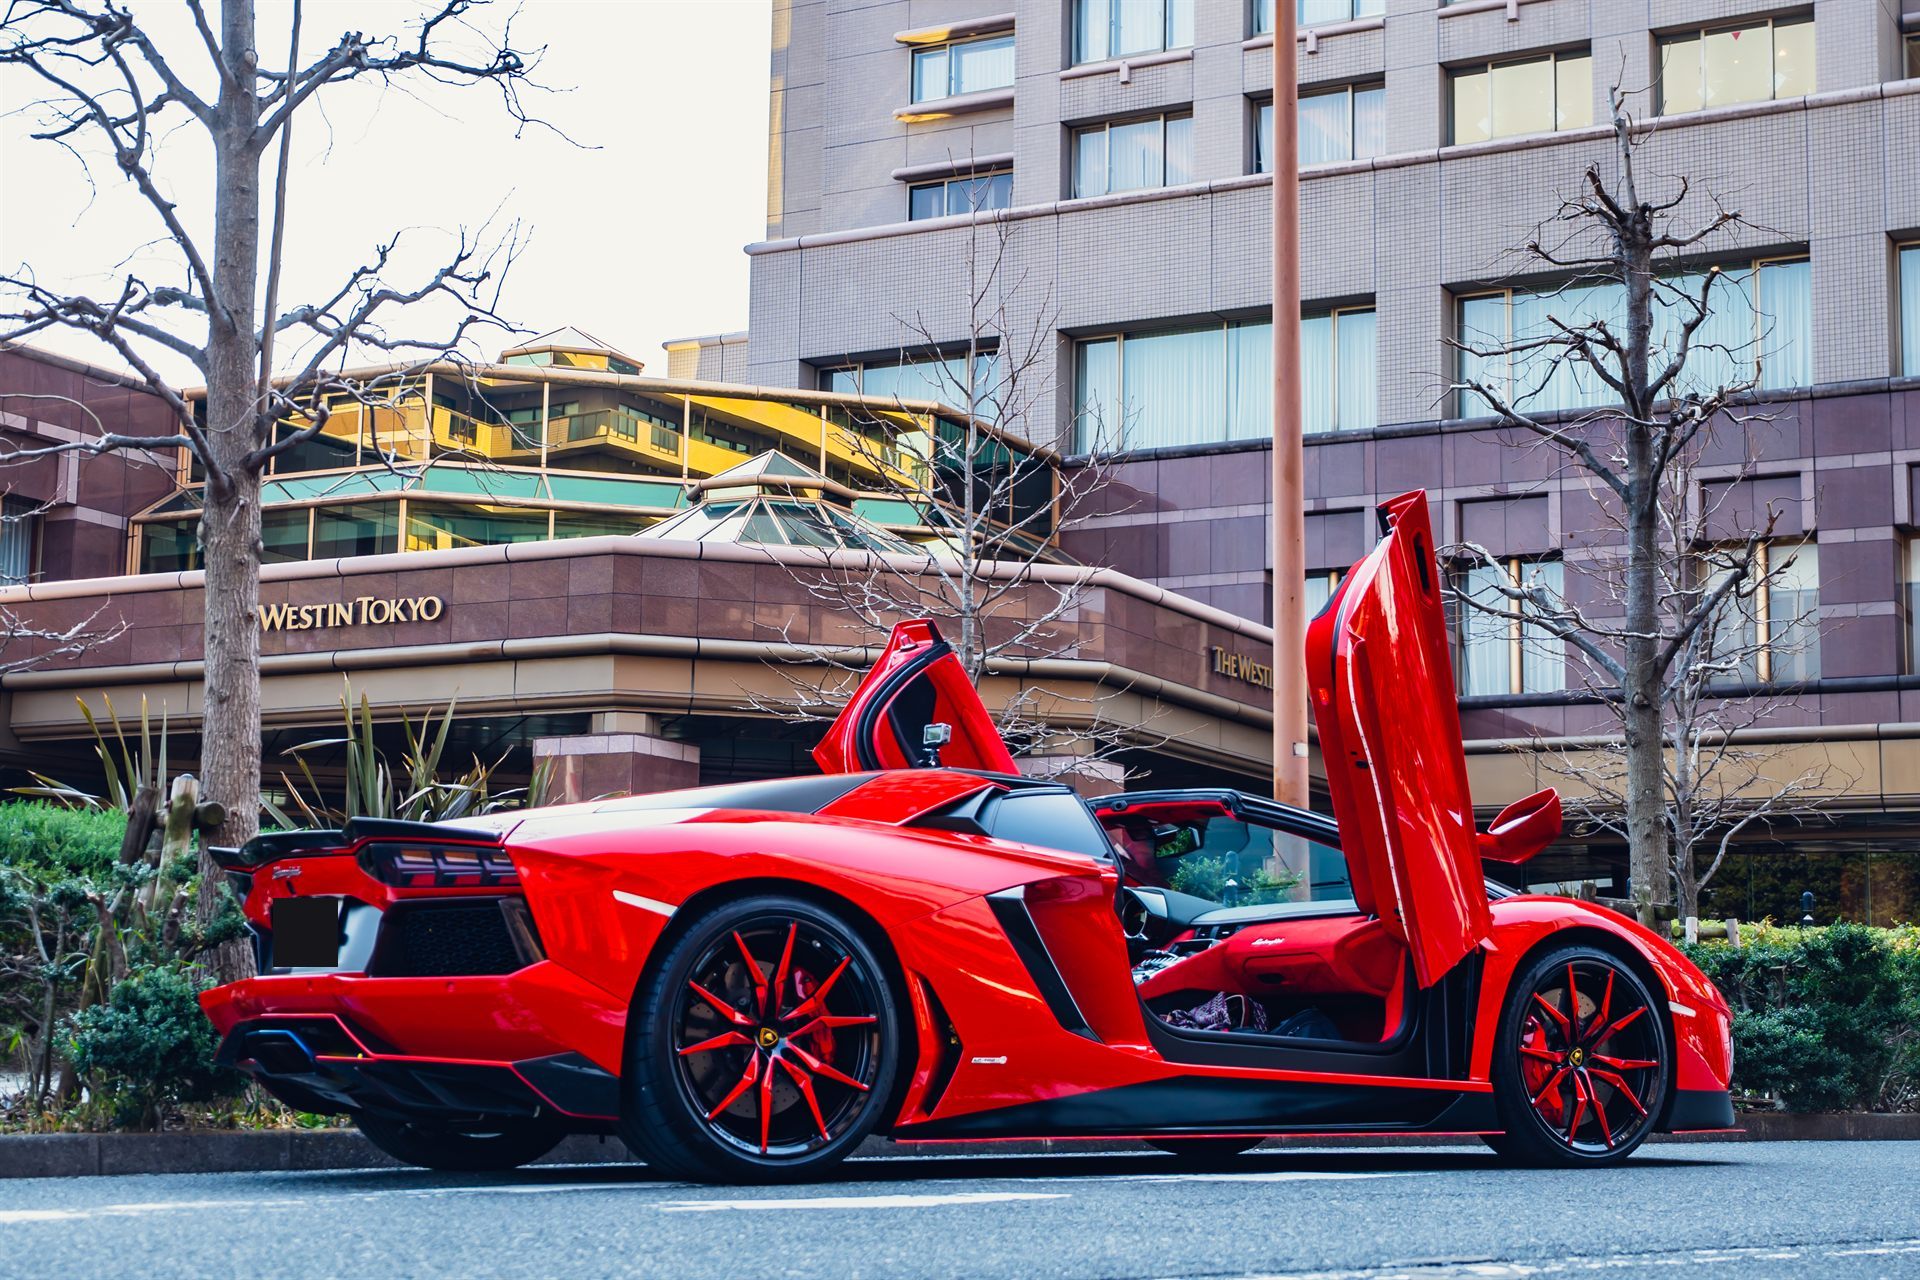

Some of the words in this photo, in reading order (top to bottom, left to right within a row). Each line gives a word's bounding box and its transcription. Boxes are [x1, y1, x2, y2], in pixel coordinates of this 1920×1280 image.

[258, 603, 353, 632] WESTIN
[356, 595, 442, 625] TOKYO
[1212, 645, 1237, 677] THE
